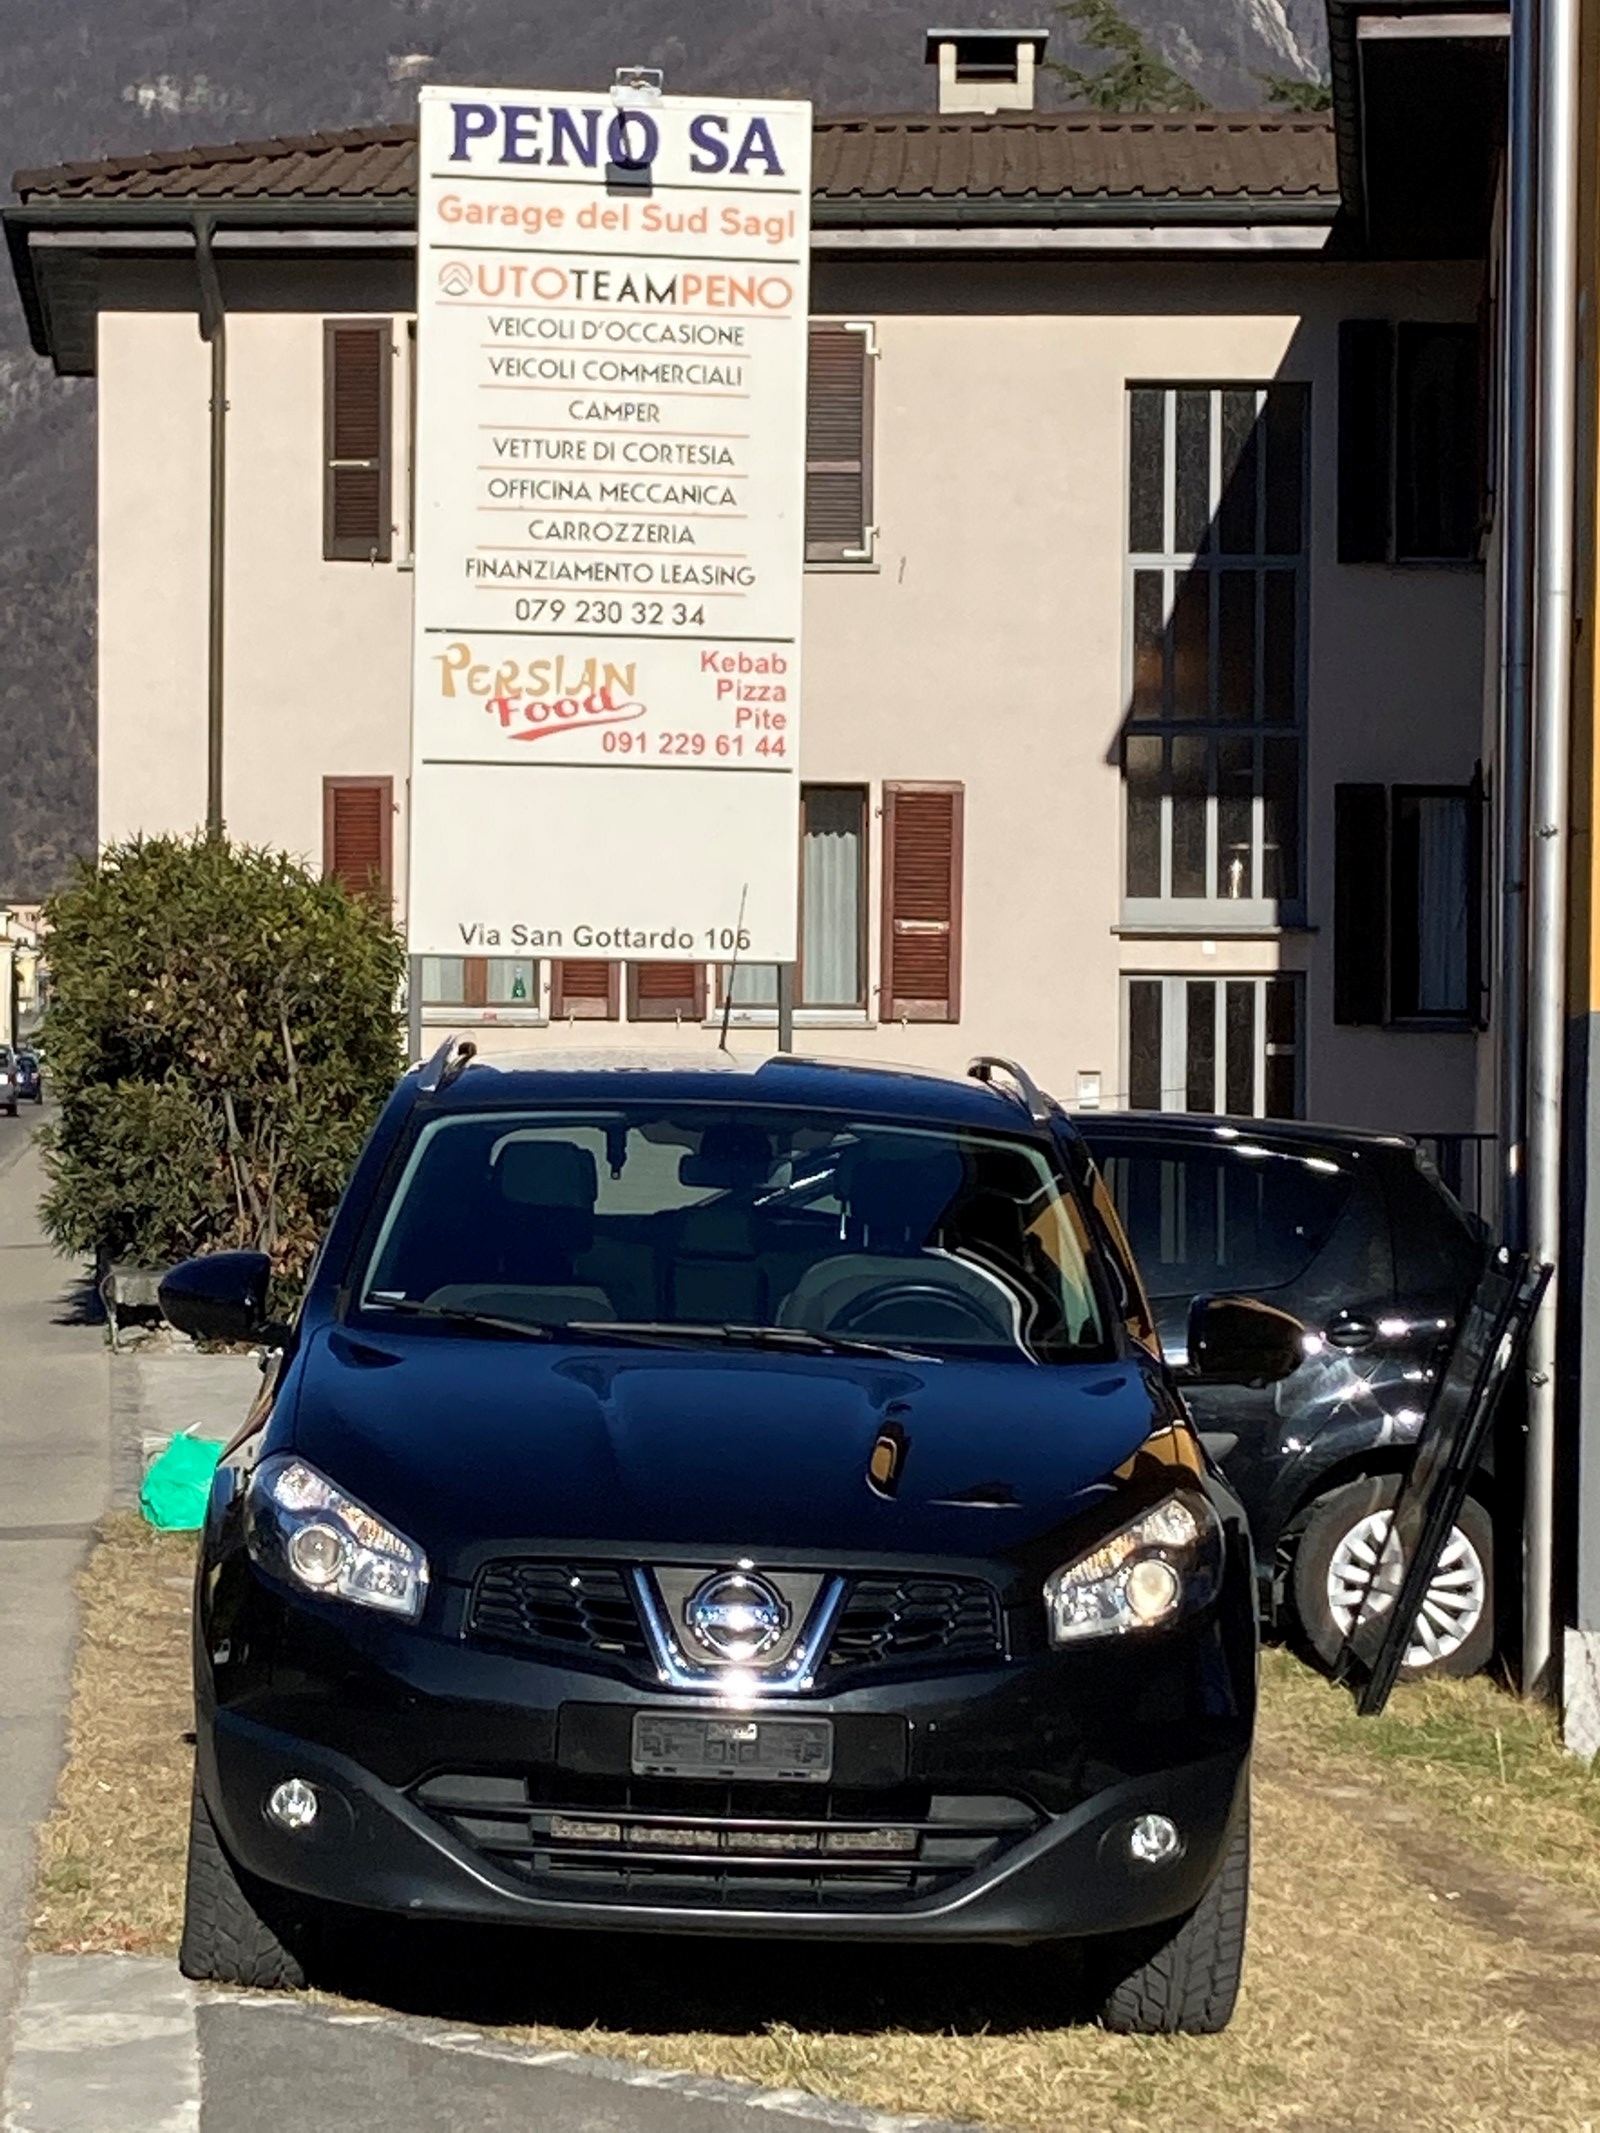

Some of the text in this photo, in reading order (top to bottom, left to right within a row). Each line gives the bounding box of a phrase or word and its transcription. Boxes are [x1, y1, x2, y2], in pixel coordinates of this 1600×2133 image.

[449, 103, 785, 176] PENO SA
[438, 195, 794, 244] Garage del Sud Sagl
[488, 316, 744, 346] VEICOLI D'OCCASIONE
[488, 357, 742, 386] VEICOLI COMMERCIALI
[568, 400, 660, 423] CAMPER
[493, 437, 735, 466] VETTURE DI CORTESIA
[488, 478, 737, 506] OFFICINA MECCANICA
[528, 519, 696, 545] CARROZZERIA
[465, 558, 756, 586] FINANZIAMENTO LEASING
[515, 598, 705, 626] 079 230 32 34
[700, 650, 788, 675] Kebab
[717, 678, 787, 702] Pizza
[485, 686, 630, 728] Food
[735, 707, 787, 731] Pite
[602, 731, 787, 757] 091 229 61 44
[458, 922, 751, 951] Via San Gottardo 106
